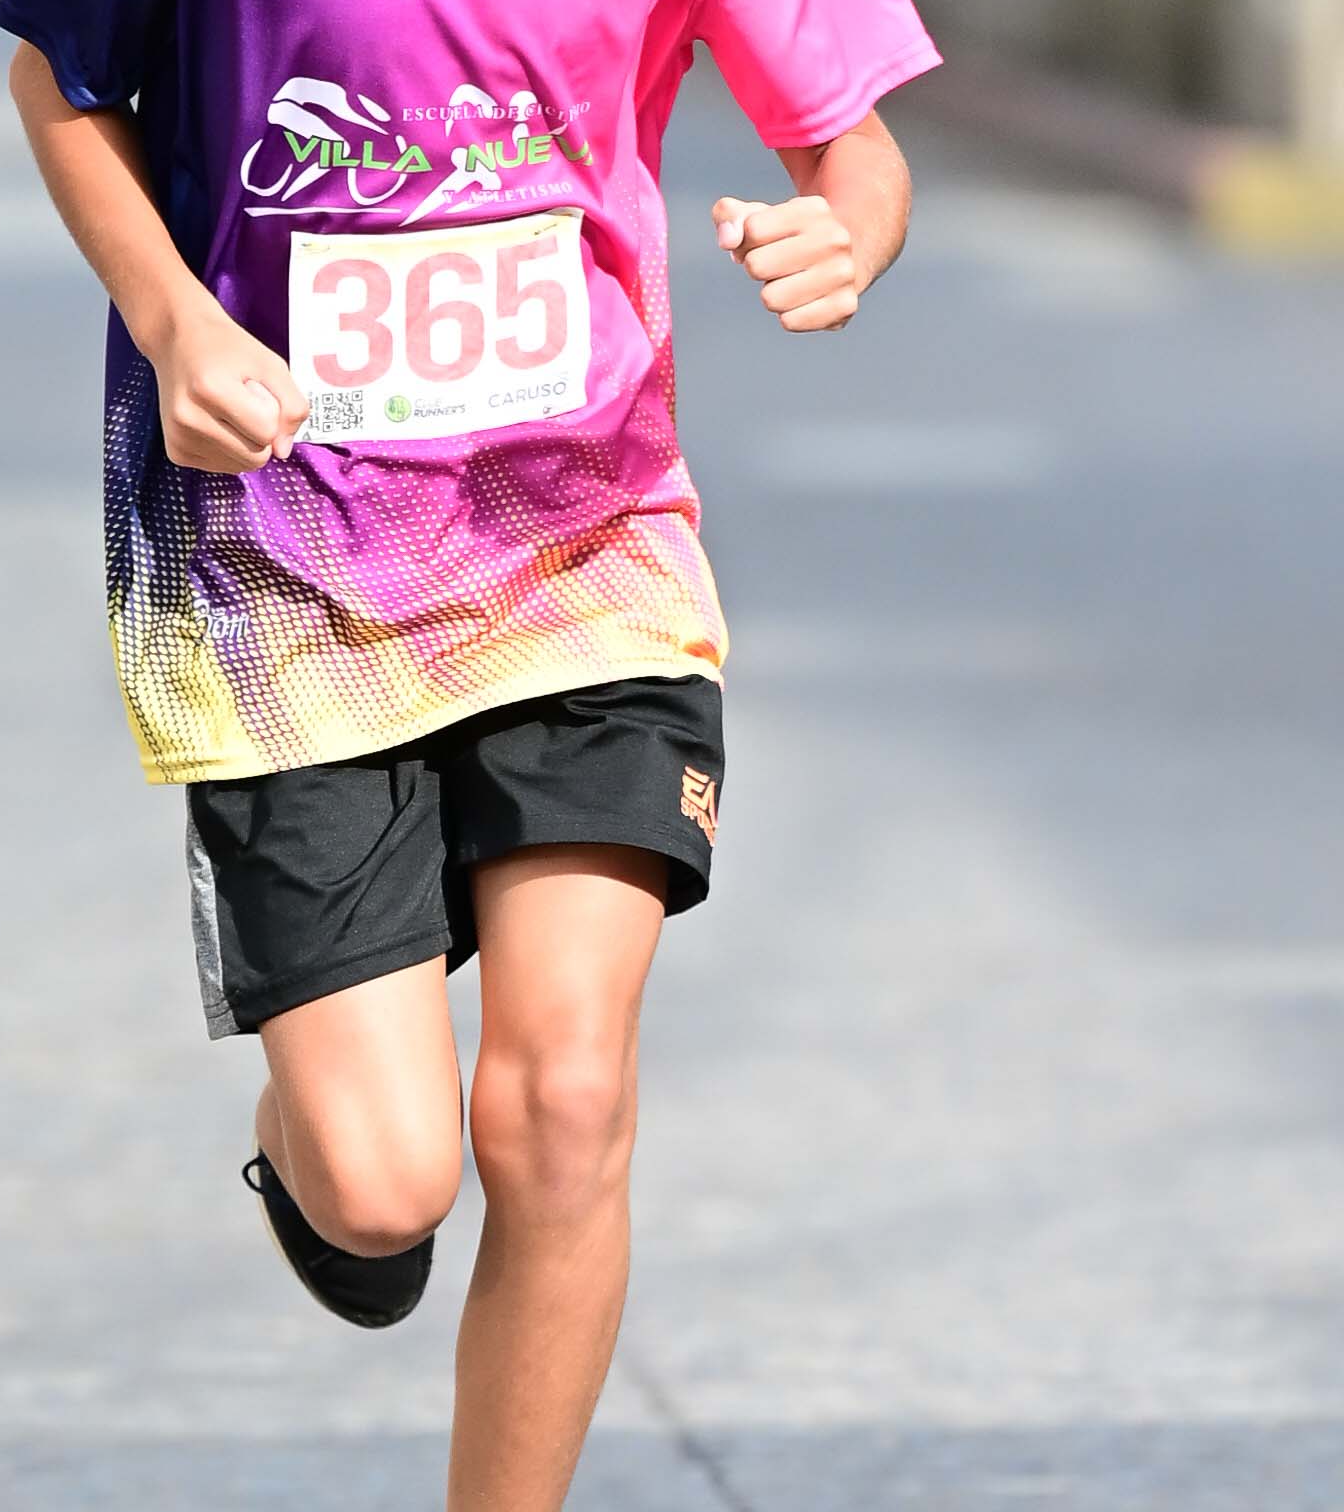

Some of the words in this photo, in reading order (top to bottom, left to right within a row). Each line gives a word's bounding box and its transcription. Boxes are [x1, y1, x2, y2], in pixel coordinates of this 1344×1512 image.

[402, 104, 485, 121] ESCUELA
[493, 105, 519, 121] DE
[283, 130, 433, 173] VILLA
[465, 134, 593, 173] NUEV
[442, 189, 455, 204] Y
[311, 235, 568, 388] 365
[488, 381, 567, 408] CARUSO
